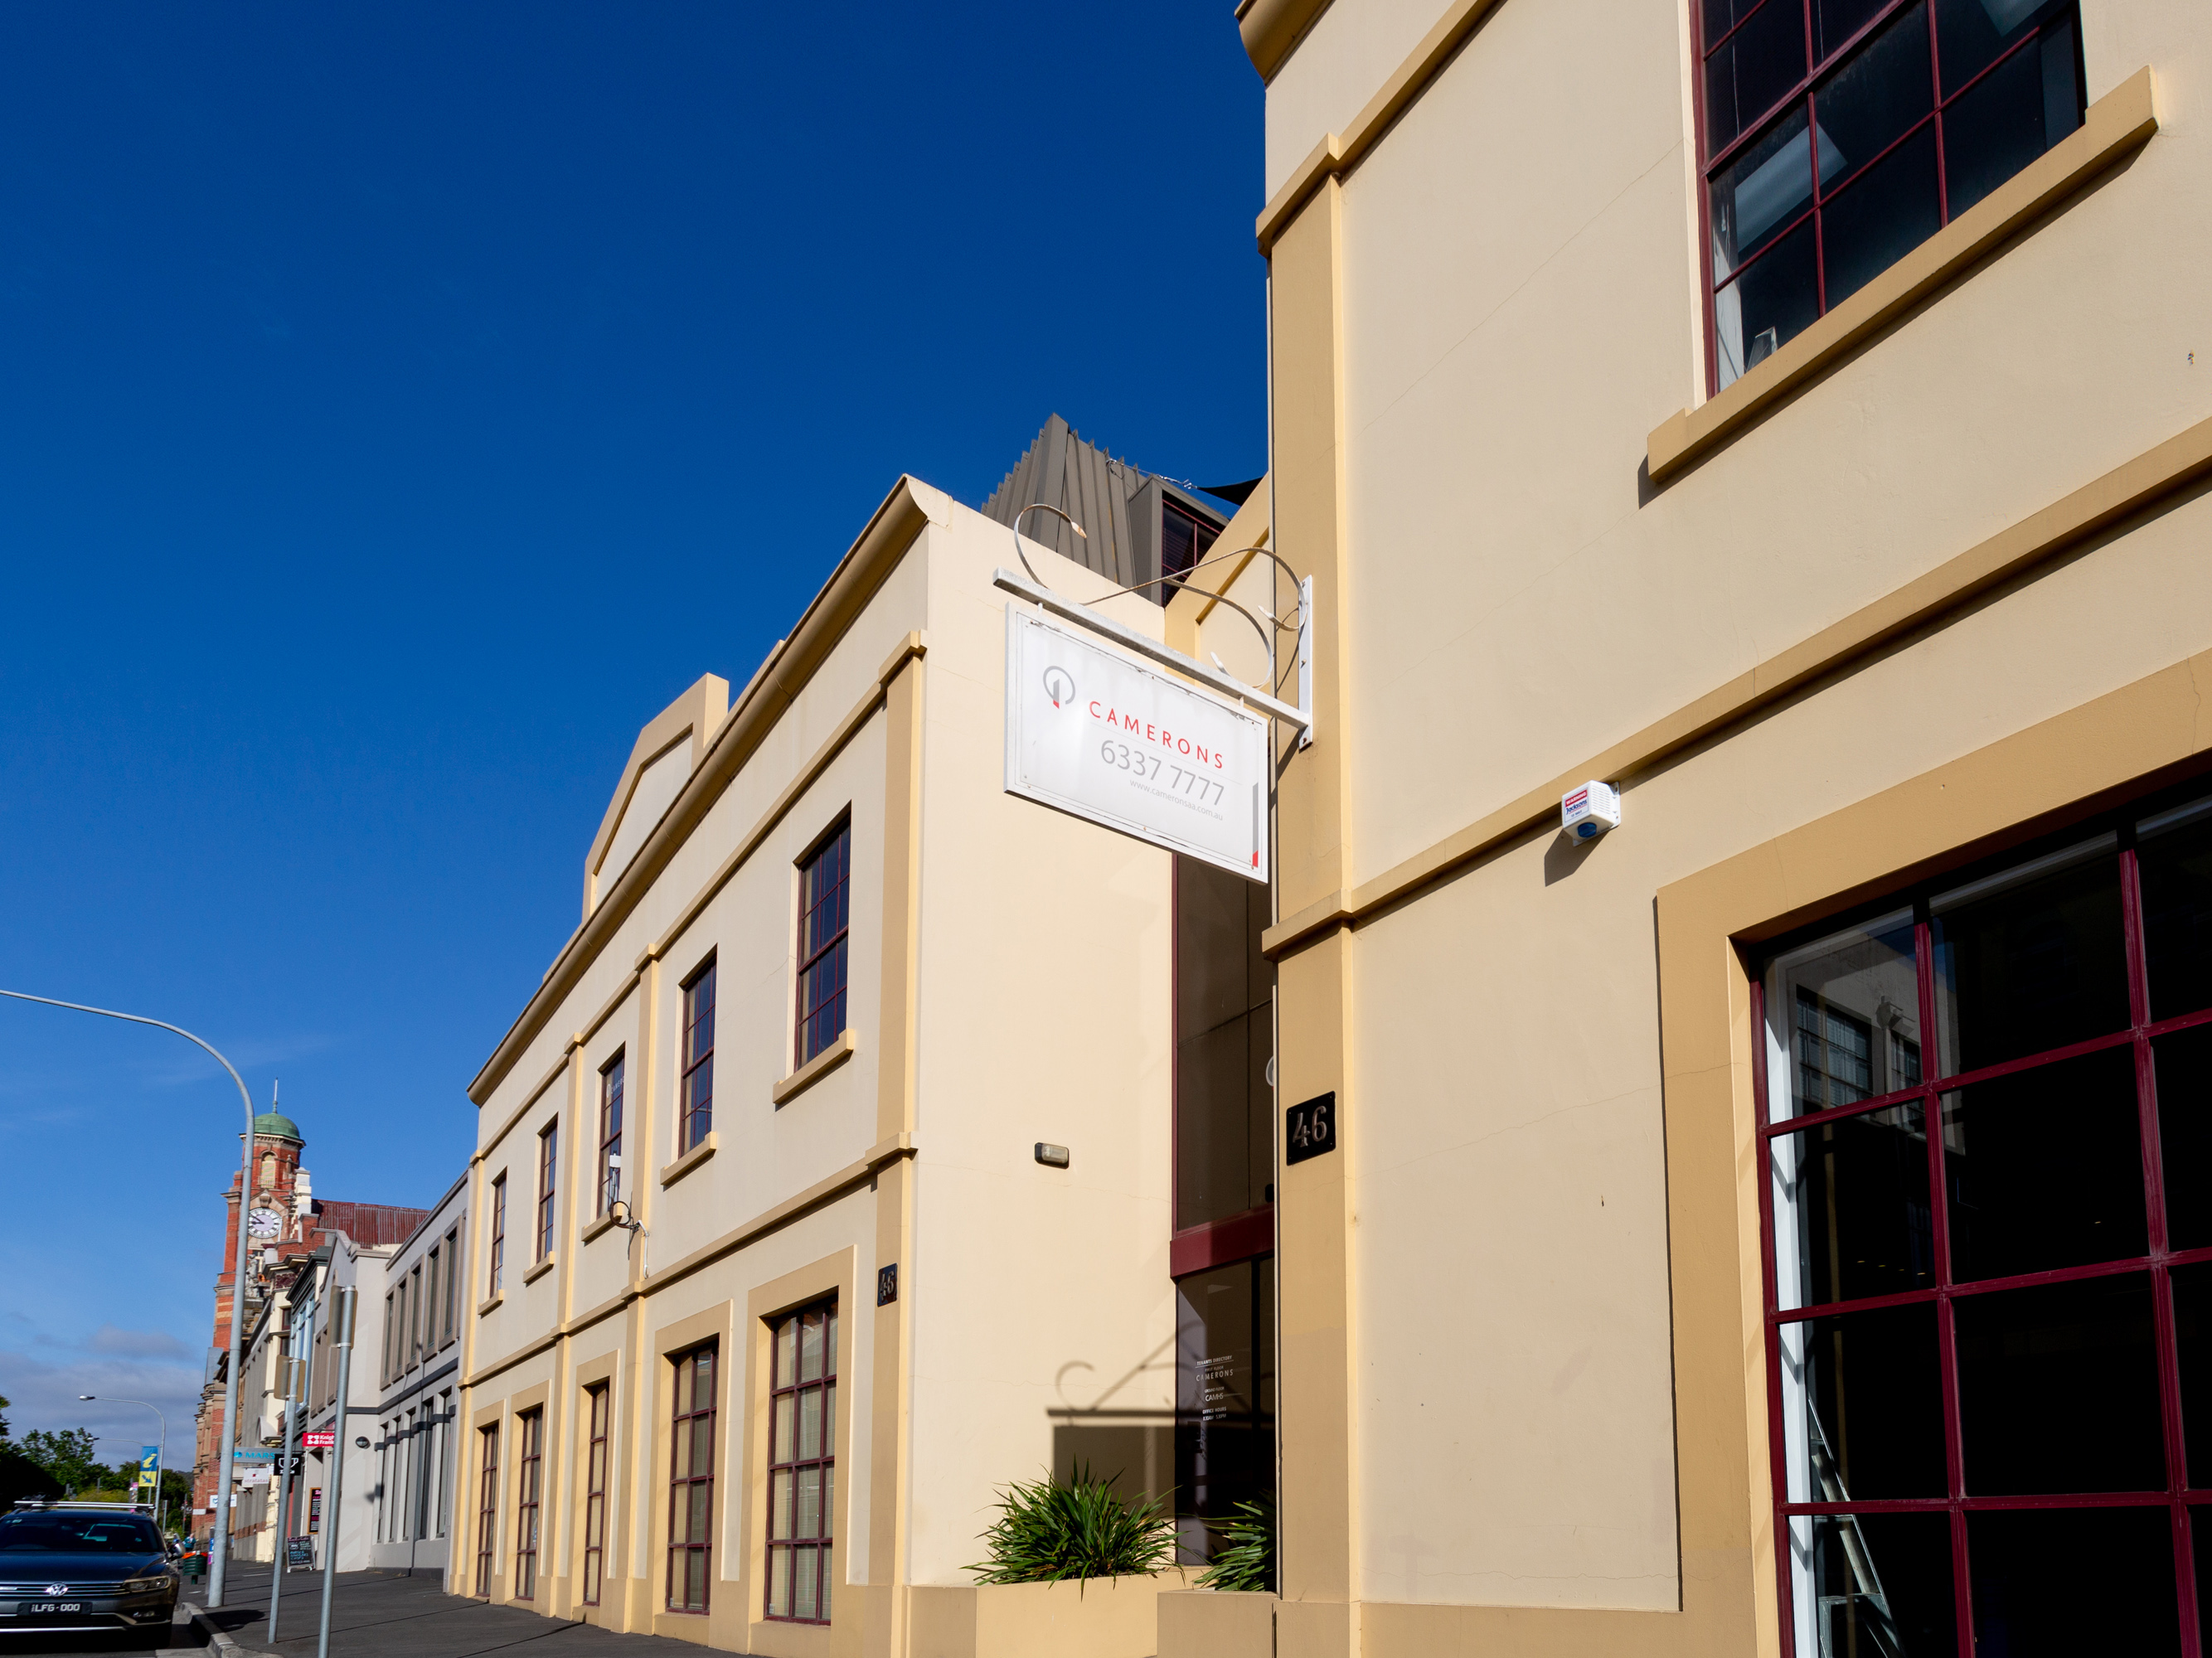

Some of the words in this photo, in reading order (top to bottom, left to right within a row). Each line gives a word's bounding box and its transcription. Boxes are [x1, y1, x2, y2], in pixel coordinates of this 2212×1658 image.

[1089, 701, 1223, 769] CAMERONS
[1100, 739, 1162, 781] 6337
[1170, 764, 1225, 806] 7777
[1129, 779, 1223, 821] www.cameronsaa.com.au
[1292, 1105, 1327, 1148] 46
[880, 1271, 895, 1297] 46
[1196, 1369, 1234, 1382] CAMERONS
[1212, 1355, 1232, 1363] DIRECTORY
